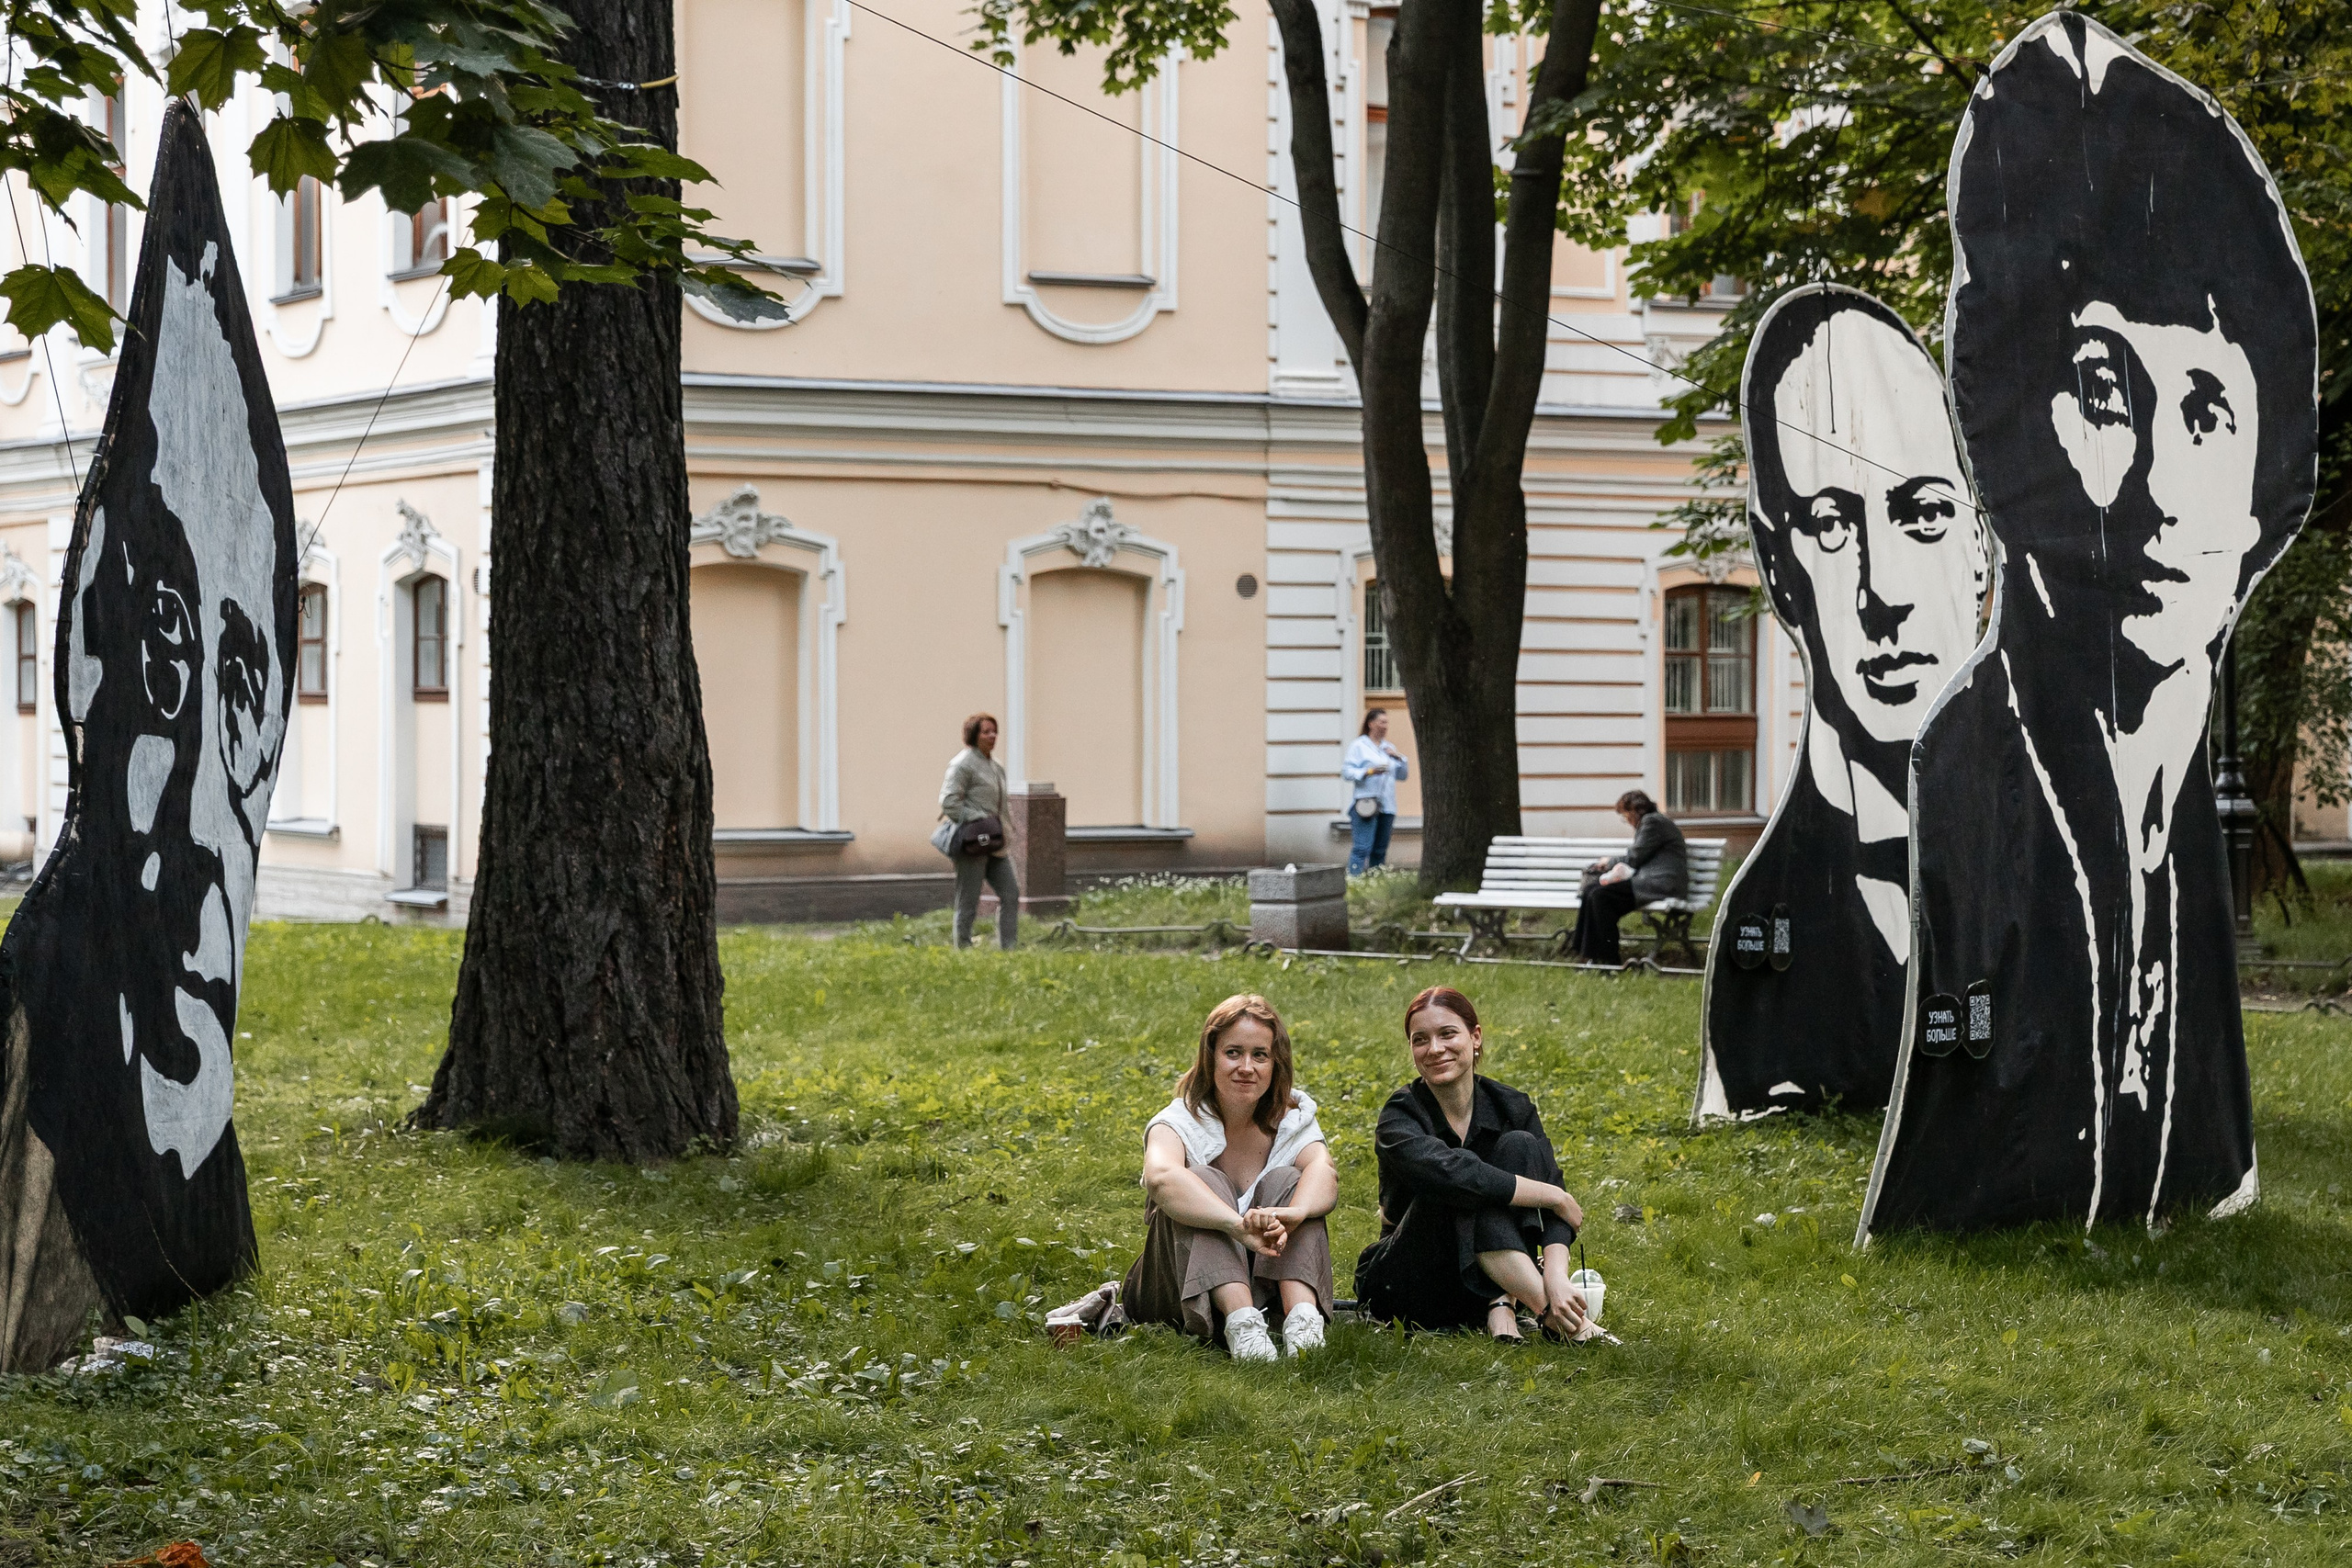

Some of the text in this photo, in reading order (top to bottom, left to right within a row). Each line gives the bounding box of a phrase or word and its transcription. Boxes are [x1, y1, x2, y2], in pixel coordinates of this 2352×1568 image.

[1736, 940, 1764, 952] БОЛЬШЕ
[1928, 1010, 1955, 1025] УЗНАТЬ
[1926, 1027, 1957, 1043] БОЛЬШЕ
